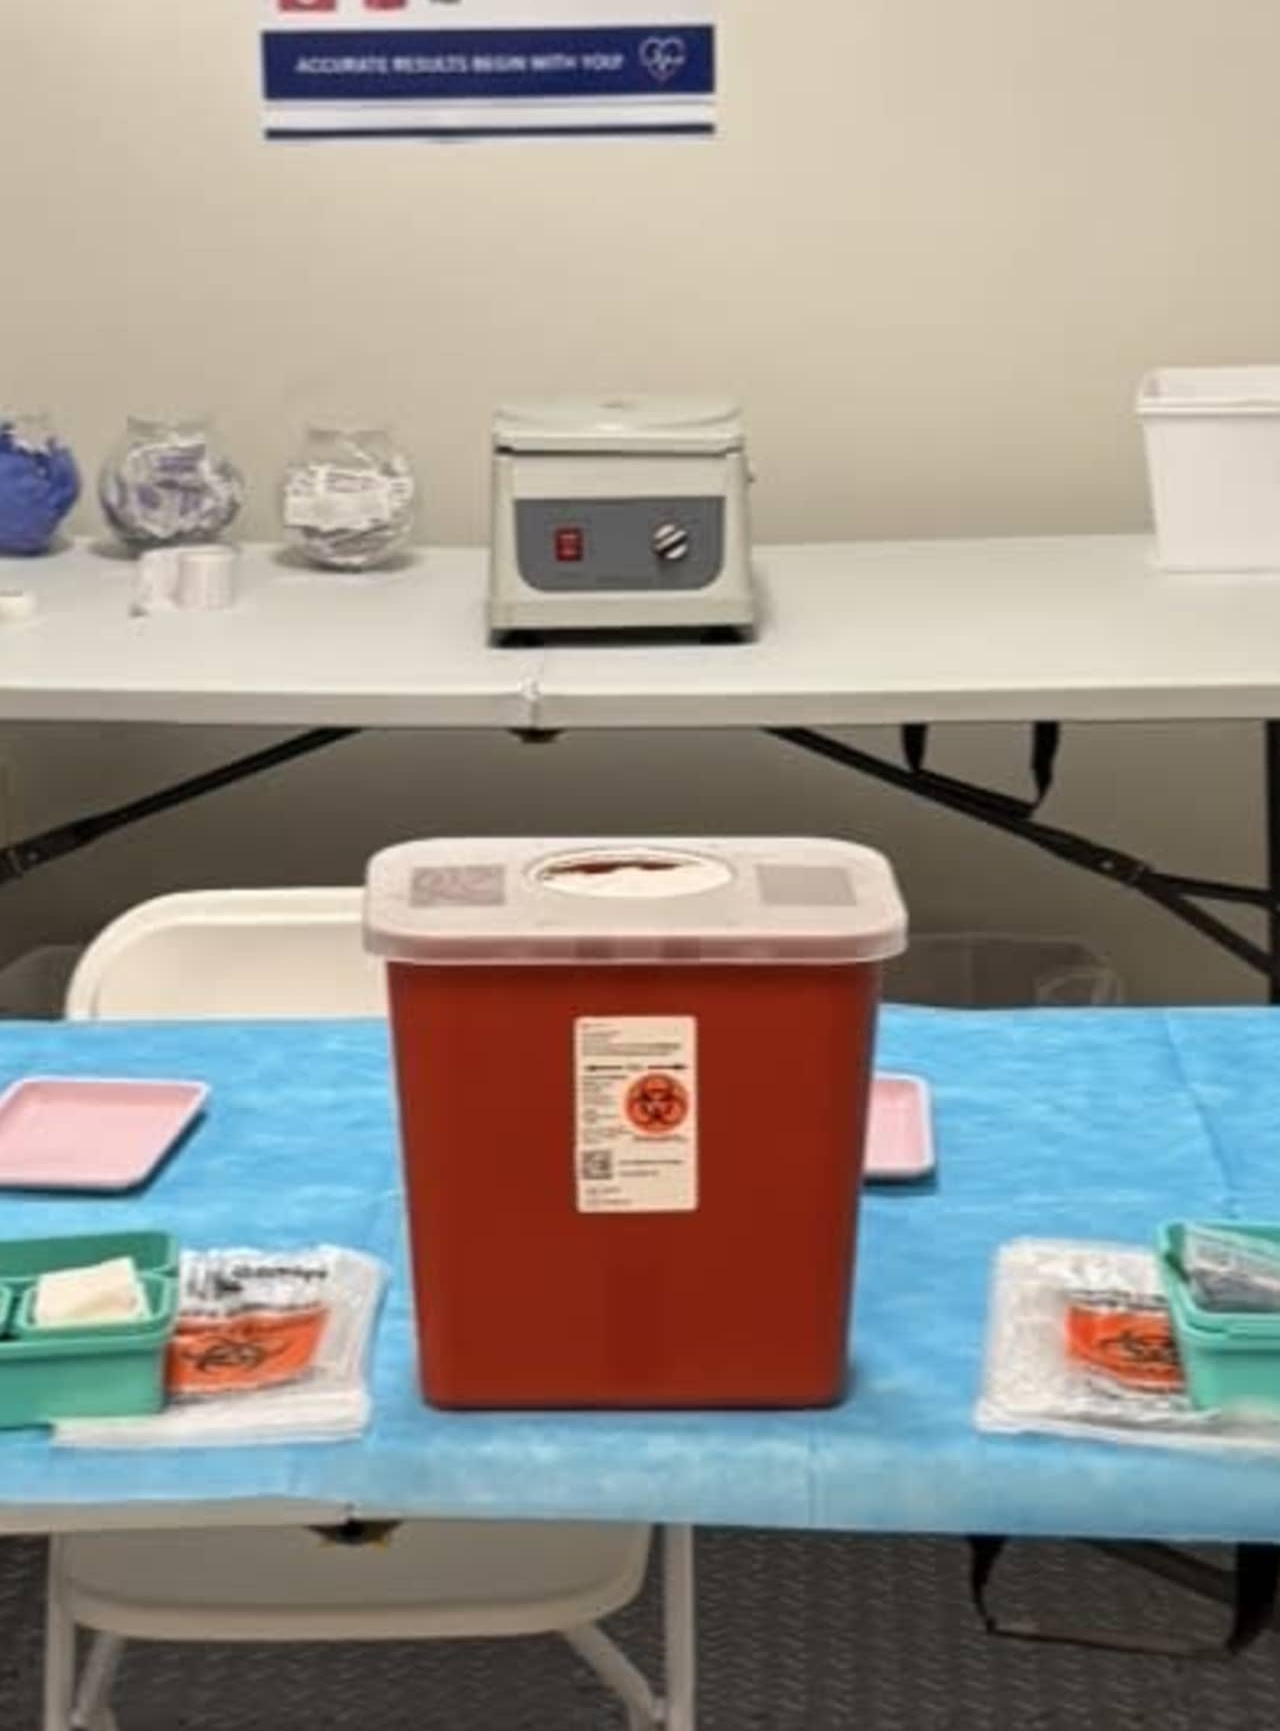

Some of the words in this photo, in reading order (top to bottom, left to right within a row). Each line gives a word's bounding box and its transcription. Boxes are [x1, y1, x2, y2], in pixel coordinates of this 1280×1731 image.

[297, 55, 388, 74] ACCURATE
[392, 55, 468, 73] RESULTS
[471, 54, 526, 72] BEGIN
[530, 53, 576, 70] WITH
